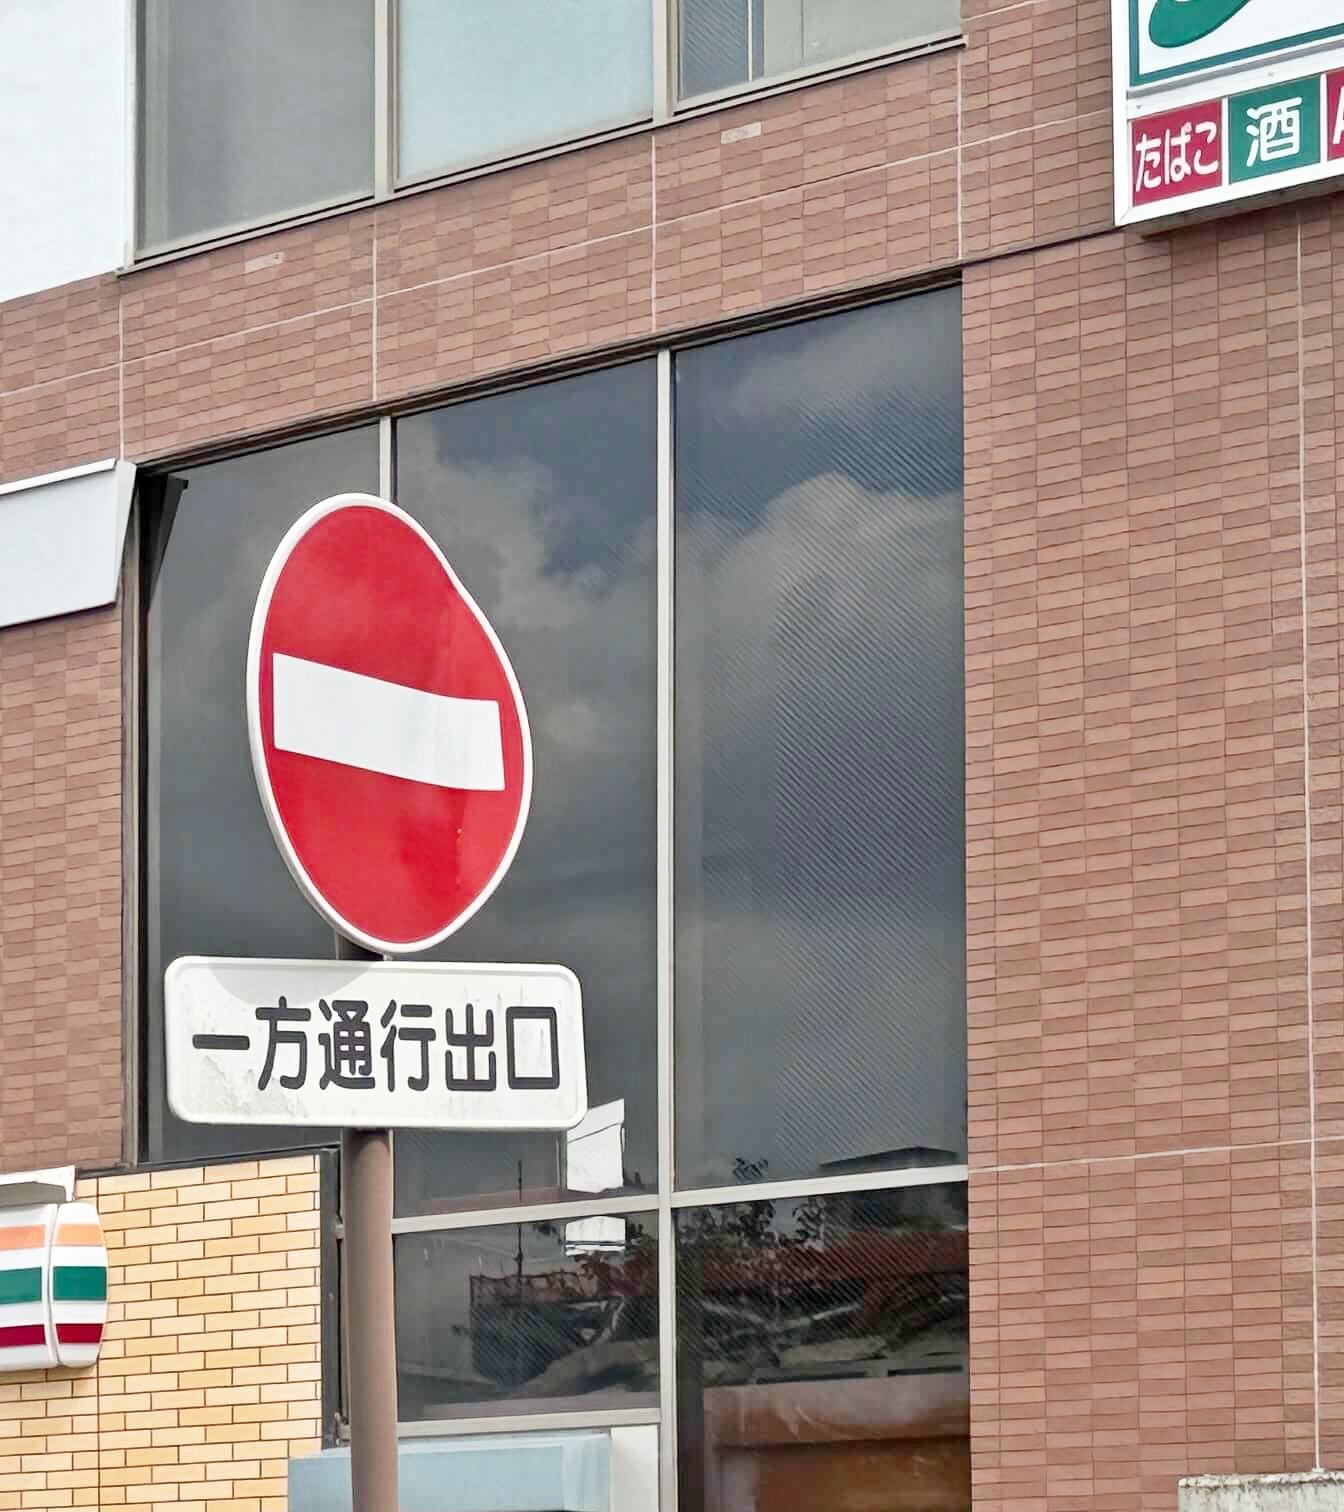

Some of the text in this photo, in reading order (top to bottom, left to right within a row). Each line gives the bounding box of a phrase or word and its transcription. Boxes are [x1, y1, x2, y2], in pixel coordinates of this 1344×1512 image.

[1135, 120, 1219, 192] たばこ
[1245, 96, 1303, 168] 酒
[192, 996, 561, 1092] 一方通行出口
